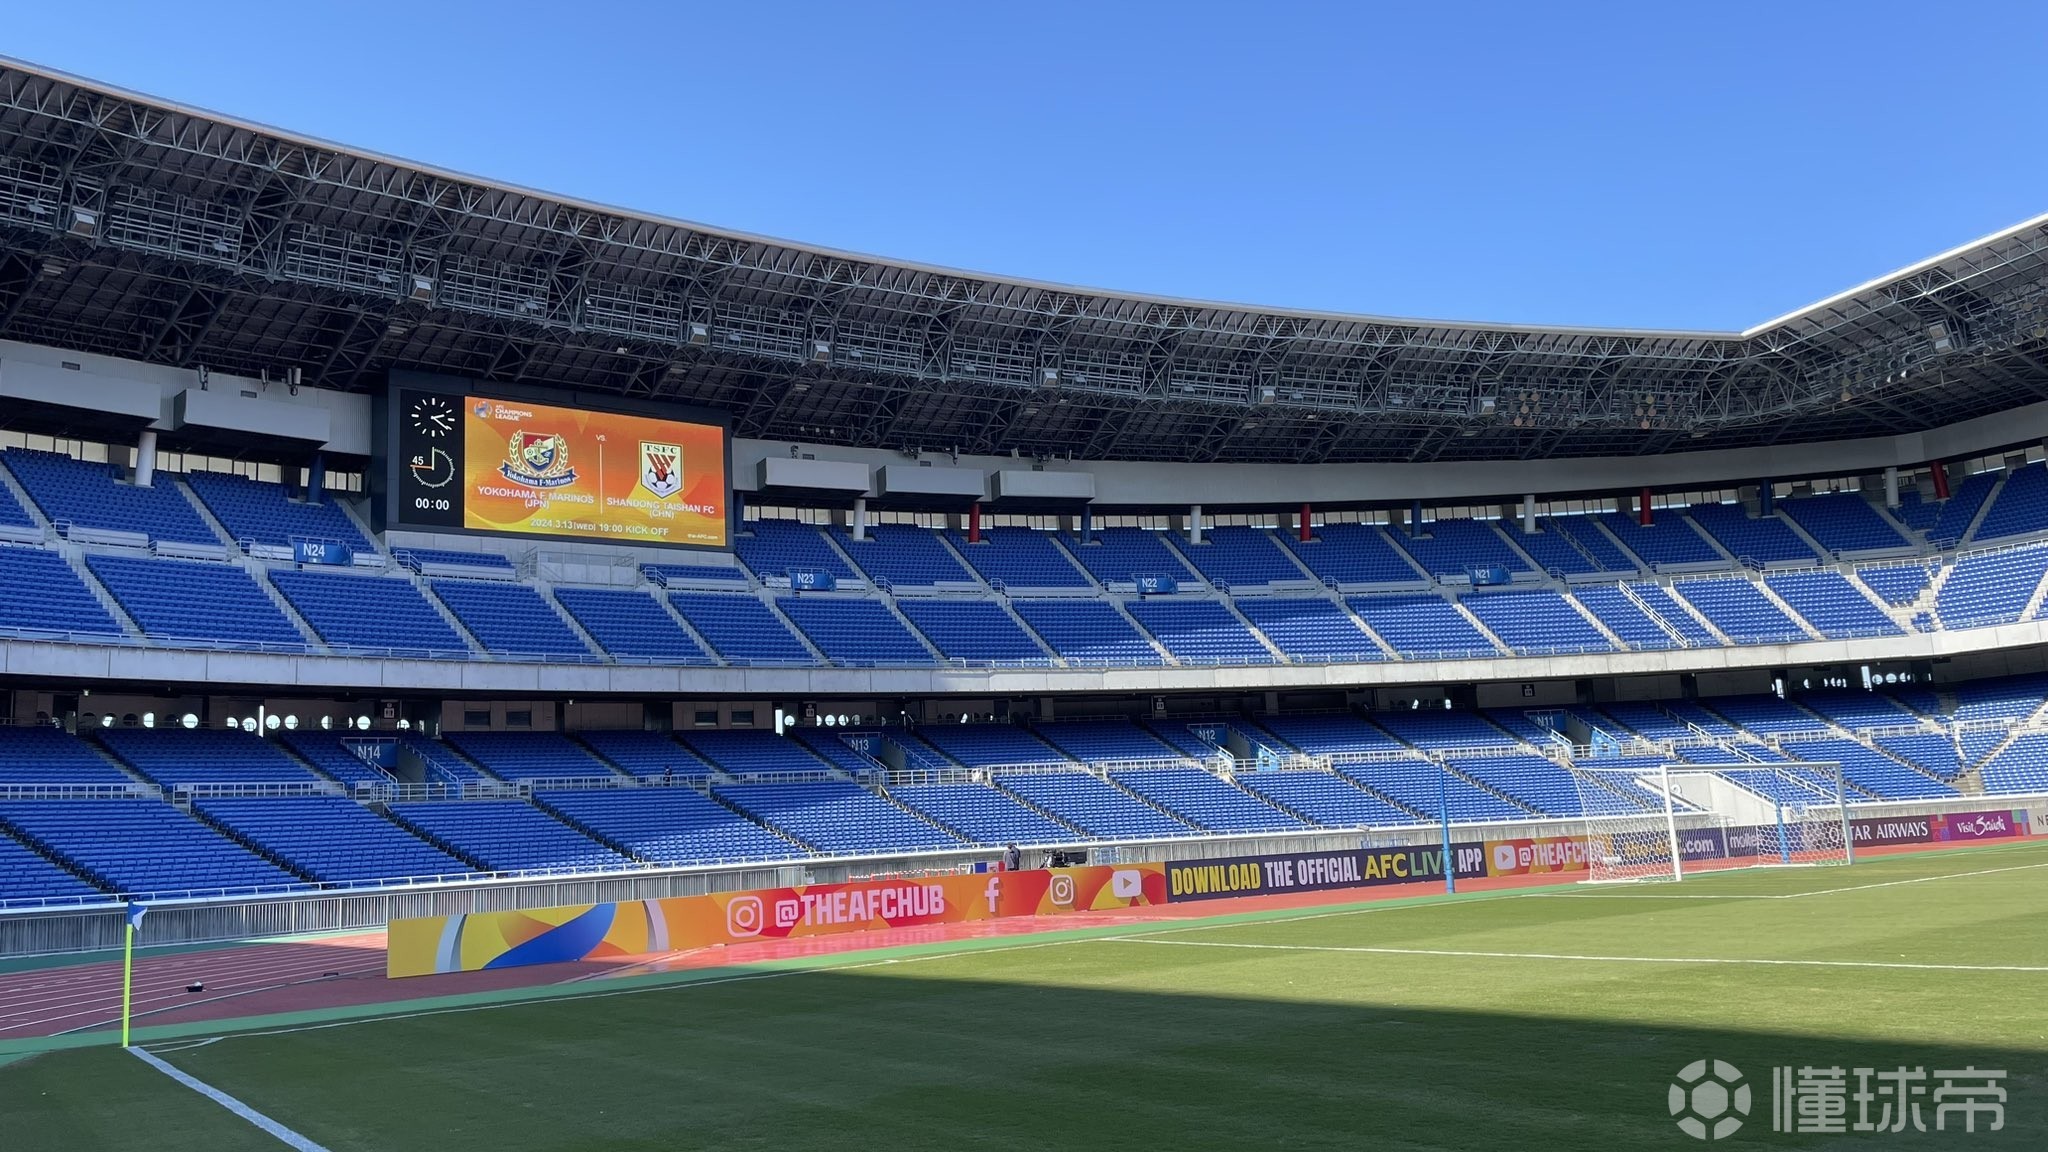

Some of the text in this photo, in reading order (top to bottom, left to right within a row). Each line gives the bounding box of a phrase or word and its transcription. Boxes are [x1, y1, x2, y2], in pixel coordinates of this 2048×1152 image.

[495, 413, 520, 421] LEAGUE
[643, 444, 677, 455] TSFC
[412, 456, 424, 465] 45
[506, 469, 538, 486] Yokohama
[477, 486, 537, 499] YOKOHAMA
[549, 493, 594, 504] MARINOS
[415, 497, 450, 511] 00:00
[525, 499, 550, 509] (JPN)
[606, 497, 715, 514] SHANDONG TAISHAN FC
[649, 509, 675, 520] (CHN)
[599, 523, 623, 533] 19:00
[625, 526, 648, 535] KICK
[650, 528, 669, 536] OFF
[303, 543, 325, 557] N24
[797, 572, 815, 584] N23
[1475, 569, 1490, 579] N21
[1141, 577, 1158, 588] N22
[1199, 729, 1216, 741] N12
[851, 739, 869, 751] N13
[357, 745, 381, 760] N14
[1829, 821, 1928, 843] QTAR AIRWAYS
[1957, 815, 2006, 836] Visit Saudi
[1171, 863, 1261, 896] DOWNLOAD
[1264, 860, 1295, 888] THE
[1297, 856, 1362, 886] OFFICIAL
[1364, 853, 1408, 880] AFC
[1457, 848, 1482, 873] APP
[775, 885, 945, 928] @THEAFCHUB
